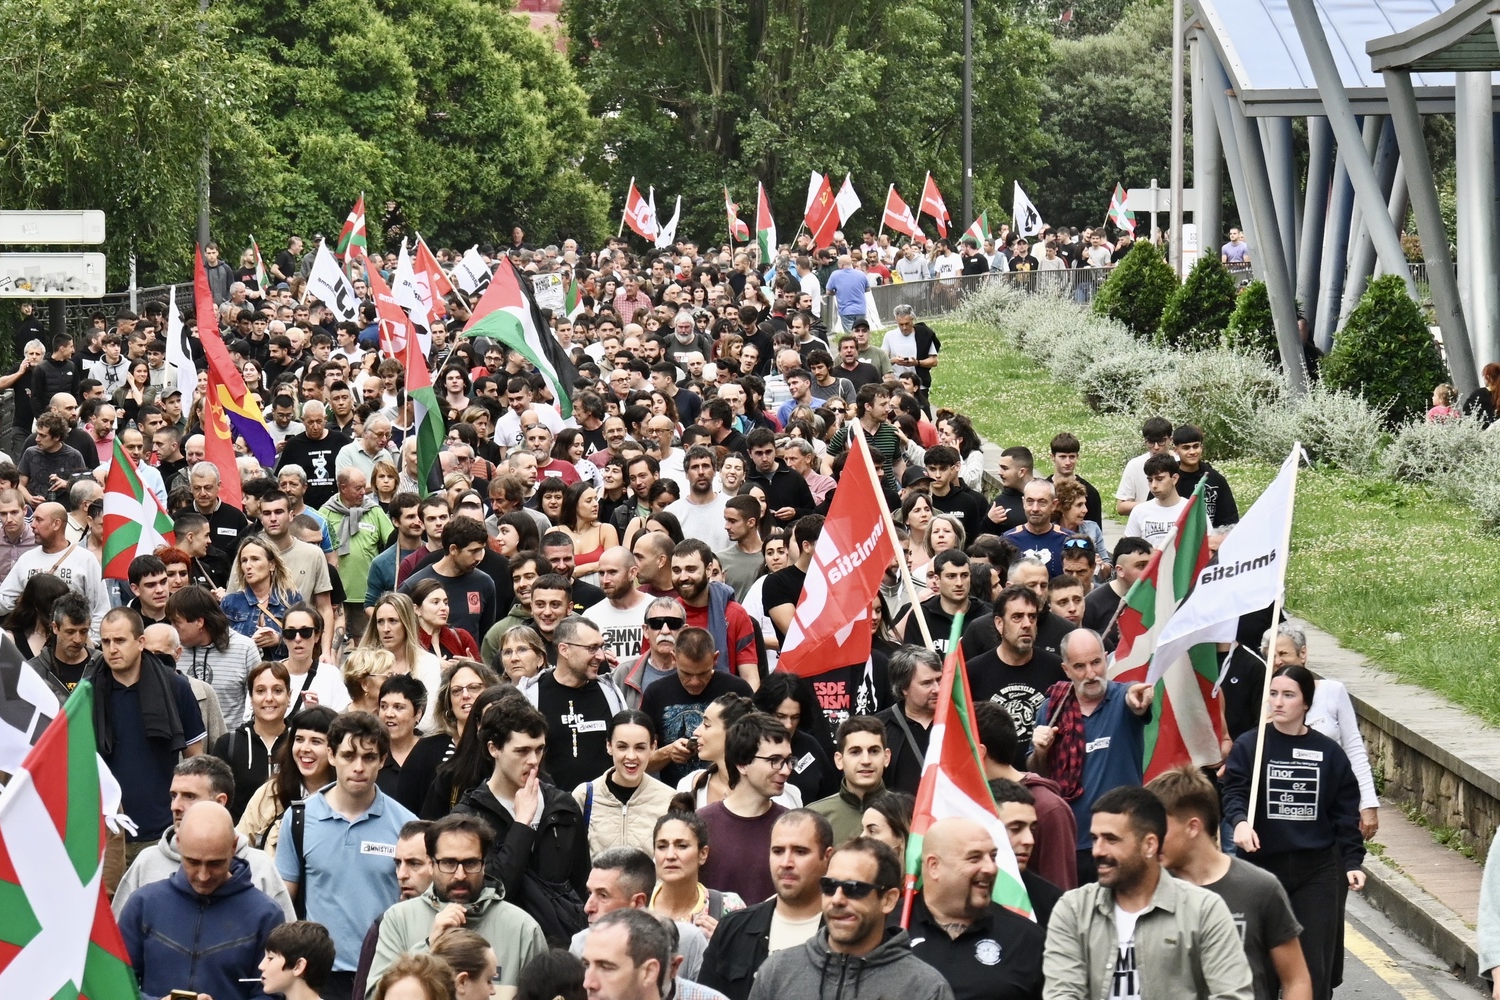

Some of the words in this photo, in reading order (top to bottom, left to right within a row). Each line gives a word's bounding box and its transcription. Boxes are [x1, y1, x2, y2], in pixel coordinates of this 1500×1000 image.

[561, 713, 584, 725] EPIC
[1271, 765, 1294, 778] inor
[1292, 782, 1307, 791] ez
[1280, 792, 1294, 803] da
[1278, 804, 1313, 815] ilegala
